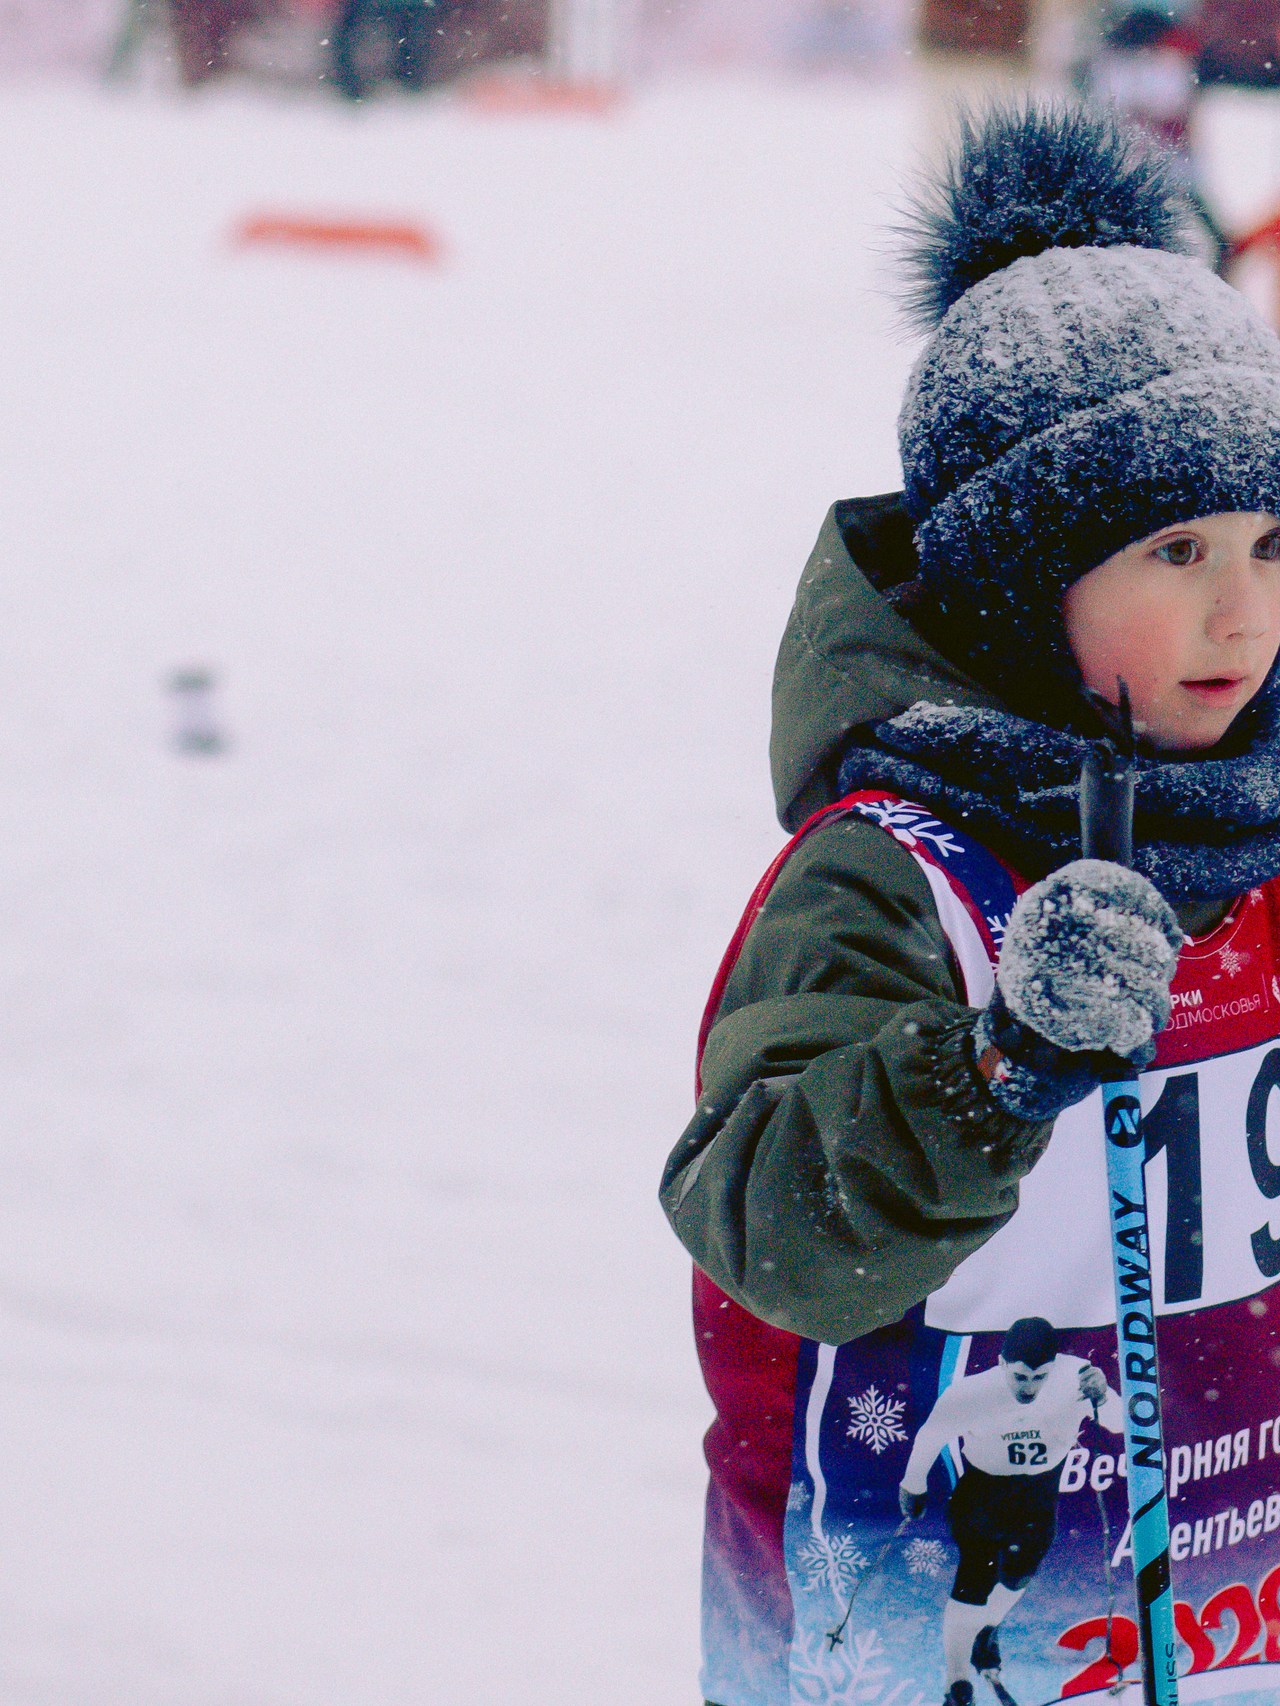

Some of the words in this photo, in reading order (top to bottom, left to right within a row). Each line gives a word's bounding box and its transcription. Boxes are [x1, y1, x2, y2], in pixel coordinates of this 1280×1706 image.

[1164, 994, 1262, 1031] ОДМОСКОВЬЯ
[1169, 989, 1203, 1010] РКИ
[1112, 1189, 1164, 1470] NORDWAY
[1007, 1442, 1048, 1466] 62
[1058, 1427, 1250, 1499] Верняя
